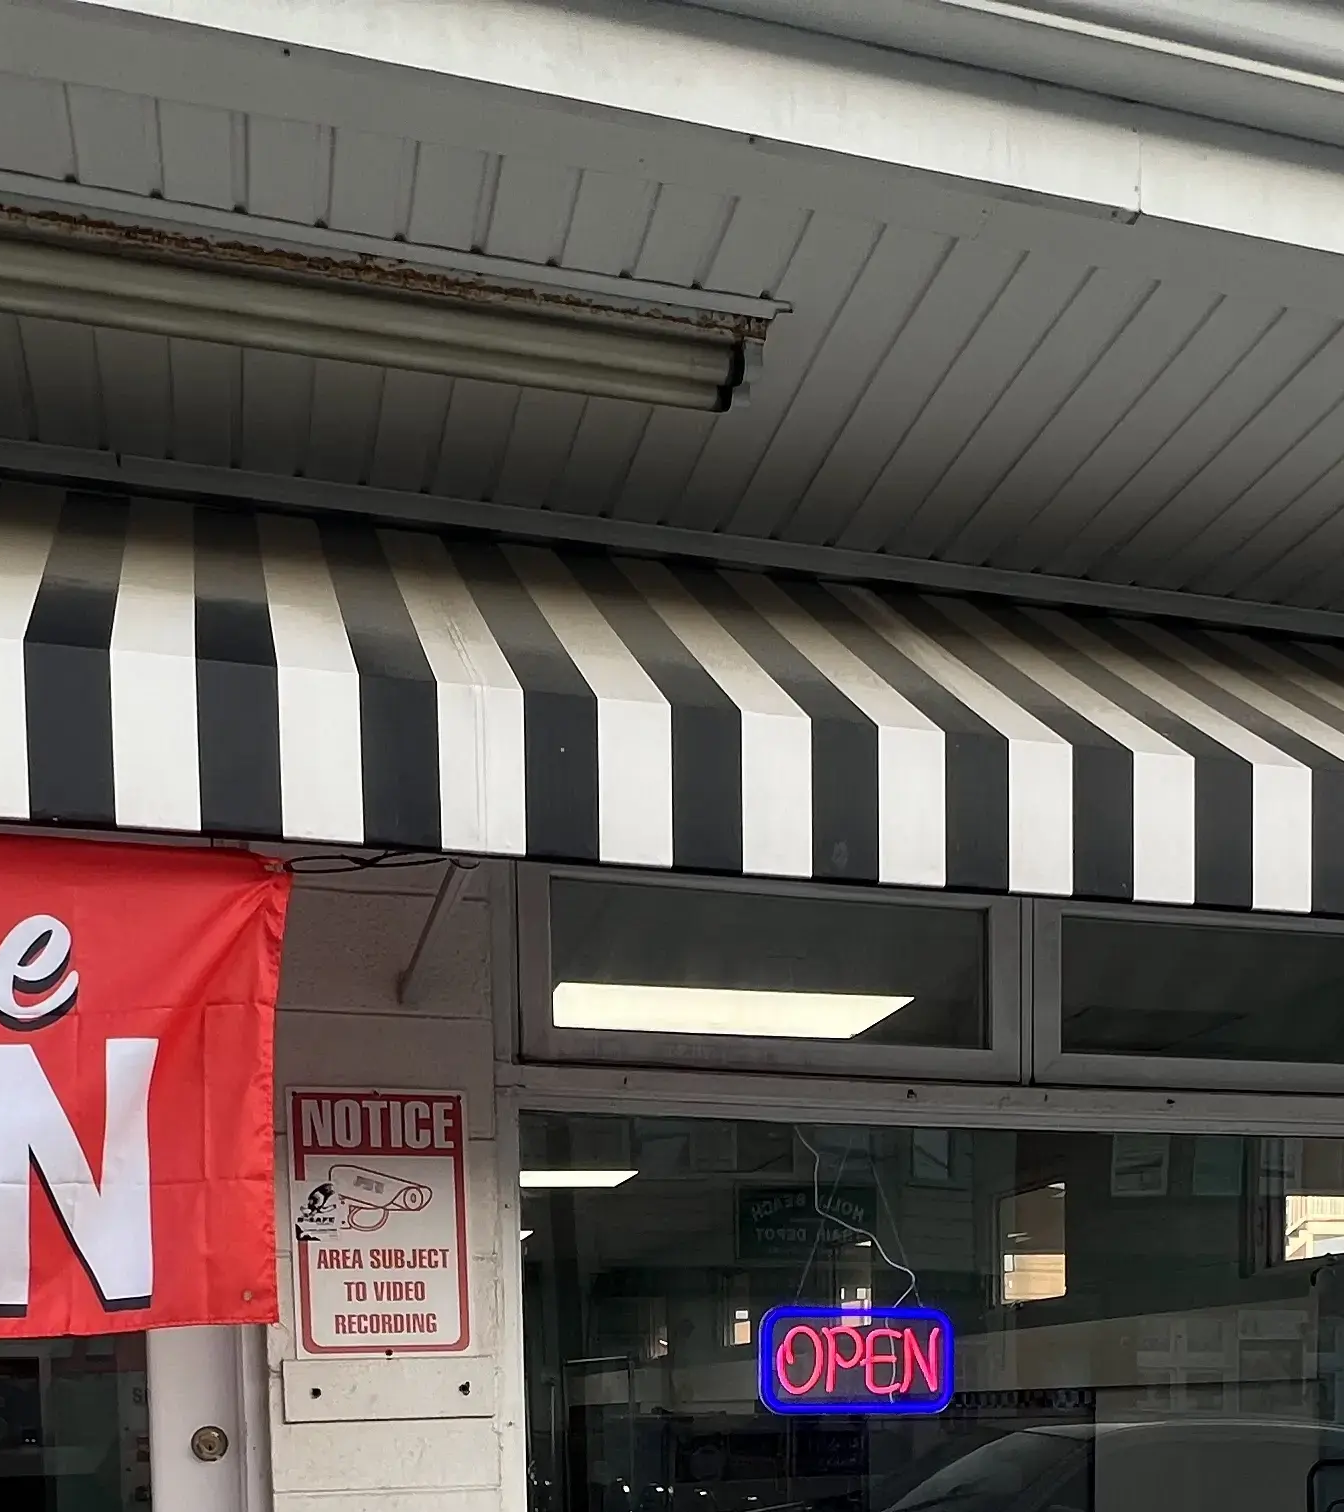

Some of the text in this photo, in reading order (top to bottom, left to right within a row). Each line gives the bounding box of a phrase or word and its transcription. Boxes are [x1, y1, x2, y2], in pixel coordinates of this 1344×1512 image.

[300, 1099, 455, 1149] NOTICE
[316, 1248, 450, 1270] AREA SUBJECT
[343, 1280, 426, 1302] TO VIDEO
[334, 1313, 438, 1335] RECORDING
[775, 1324, 941, 1395] OPEN
